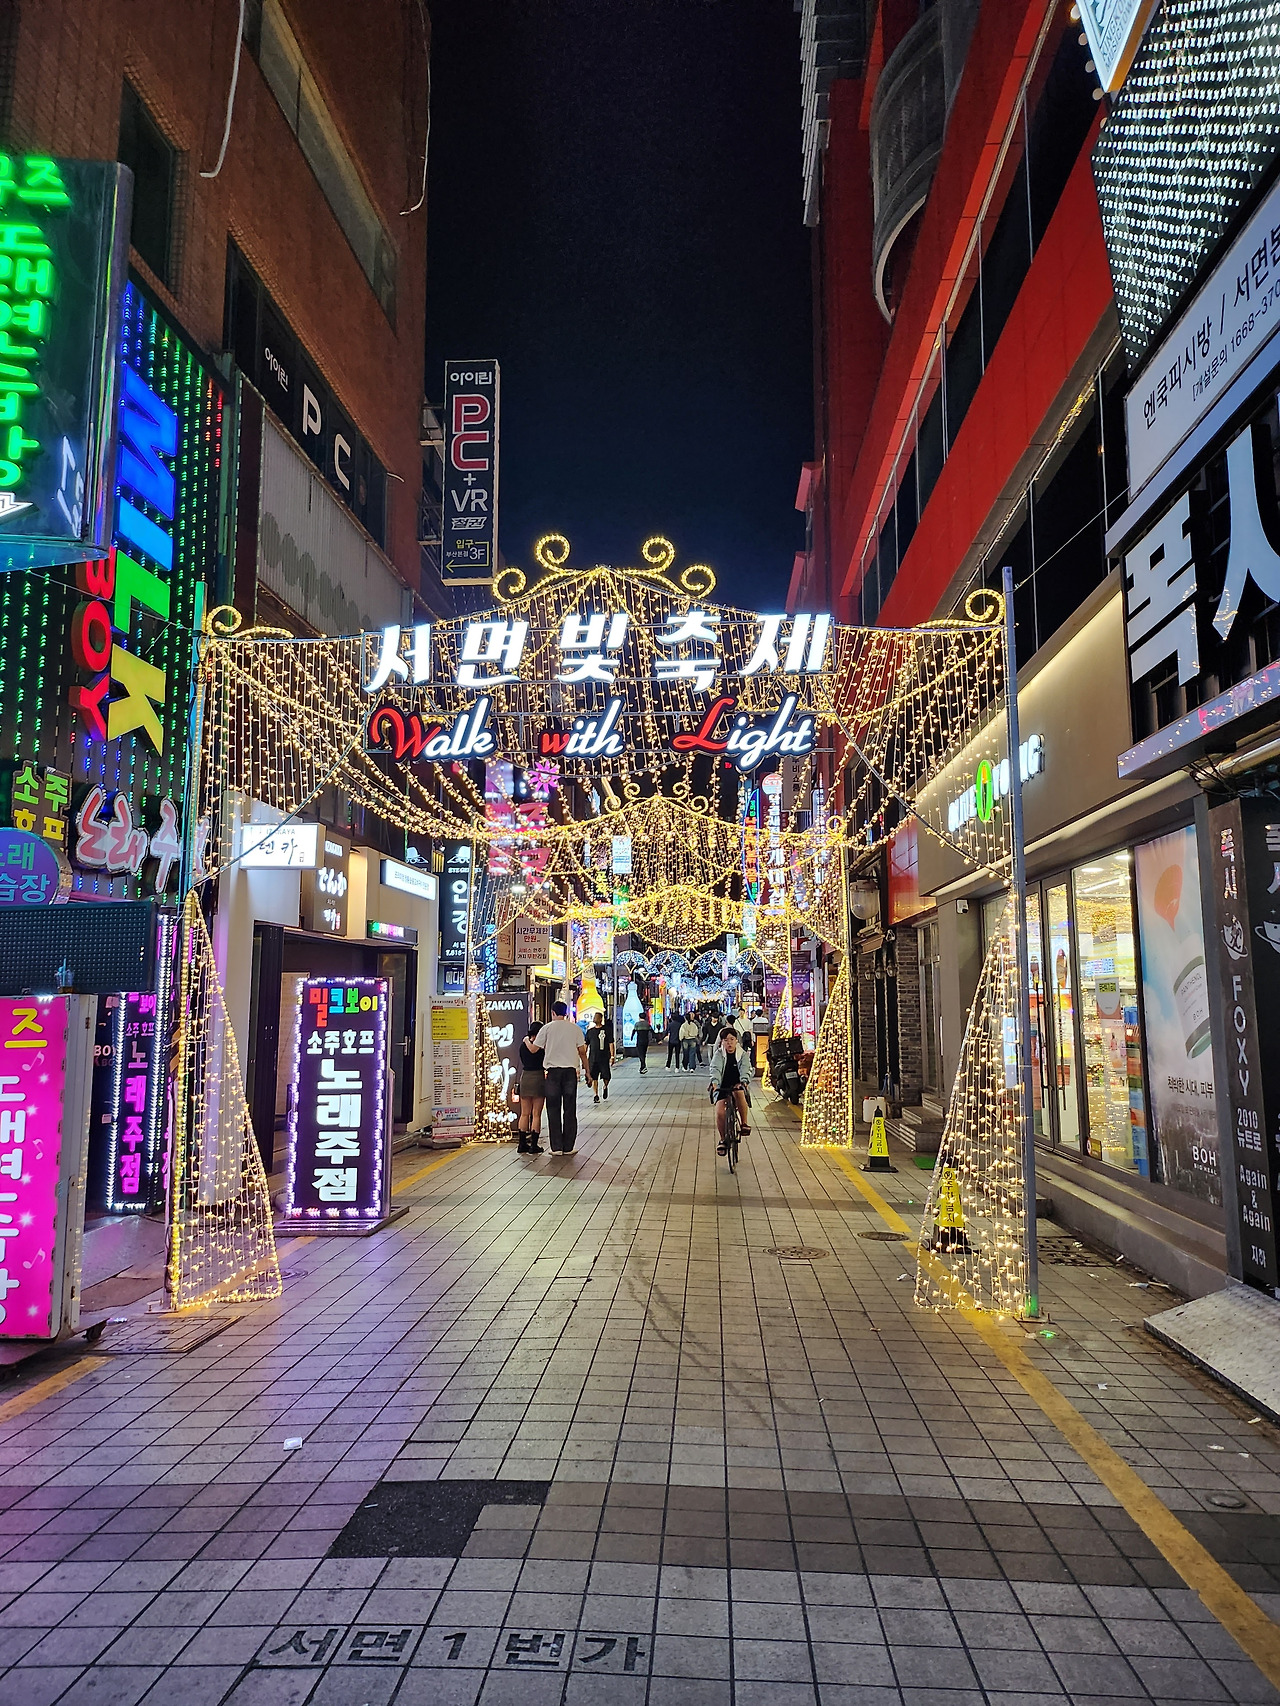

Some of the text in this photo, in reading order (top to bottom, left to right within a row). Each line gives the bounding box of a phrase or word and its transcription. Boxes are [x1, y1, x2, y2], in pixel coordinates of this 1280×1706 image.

[265, 347, 288, 392] 아이린
[1143, 316, 1212, 430] 엔쿡피시방
[452, 394, 491, 471] PC
[451, 489, 488, 513] VR
[456, 539, 474, 549] 입구
[469, 547, 485, 565] 3F
[370, 696, 816, 772] Walk with Light
[14, 767, 69, 812] 소주
[14, 810, 66, 841] 호프
[0, 842, 35, 871] 래
[516, 927, 549, 935] 시간무제한
[309, 987, 378, 1028] 밀크보이
[306, 1029, 375, 1056] 소주호프
[1232, 975, 1250, 1097] FOXY
[120, 1041, 149, 1194] 노래주점
[312, 1058, 363, 1203] 노래주점
[1237, 1107, 1258, 1130] 2010
[1236, 1128, 1262, 1152] 뉴트로
[1192, 1145, 1217, 1167] BOH
[1239, 1164, 1268, 1191] Again
[1251, 1190, 1258, 1209] &
[1243, 1204, 1271, 1233] Again
[1251, 1244, 1267, 1269] 지하
